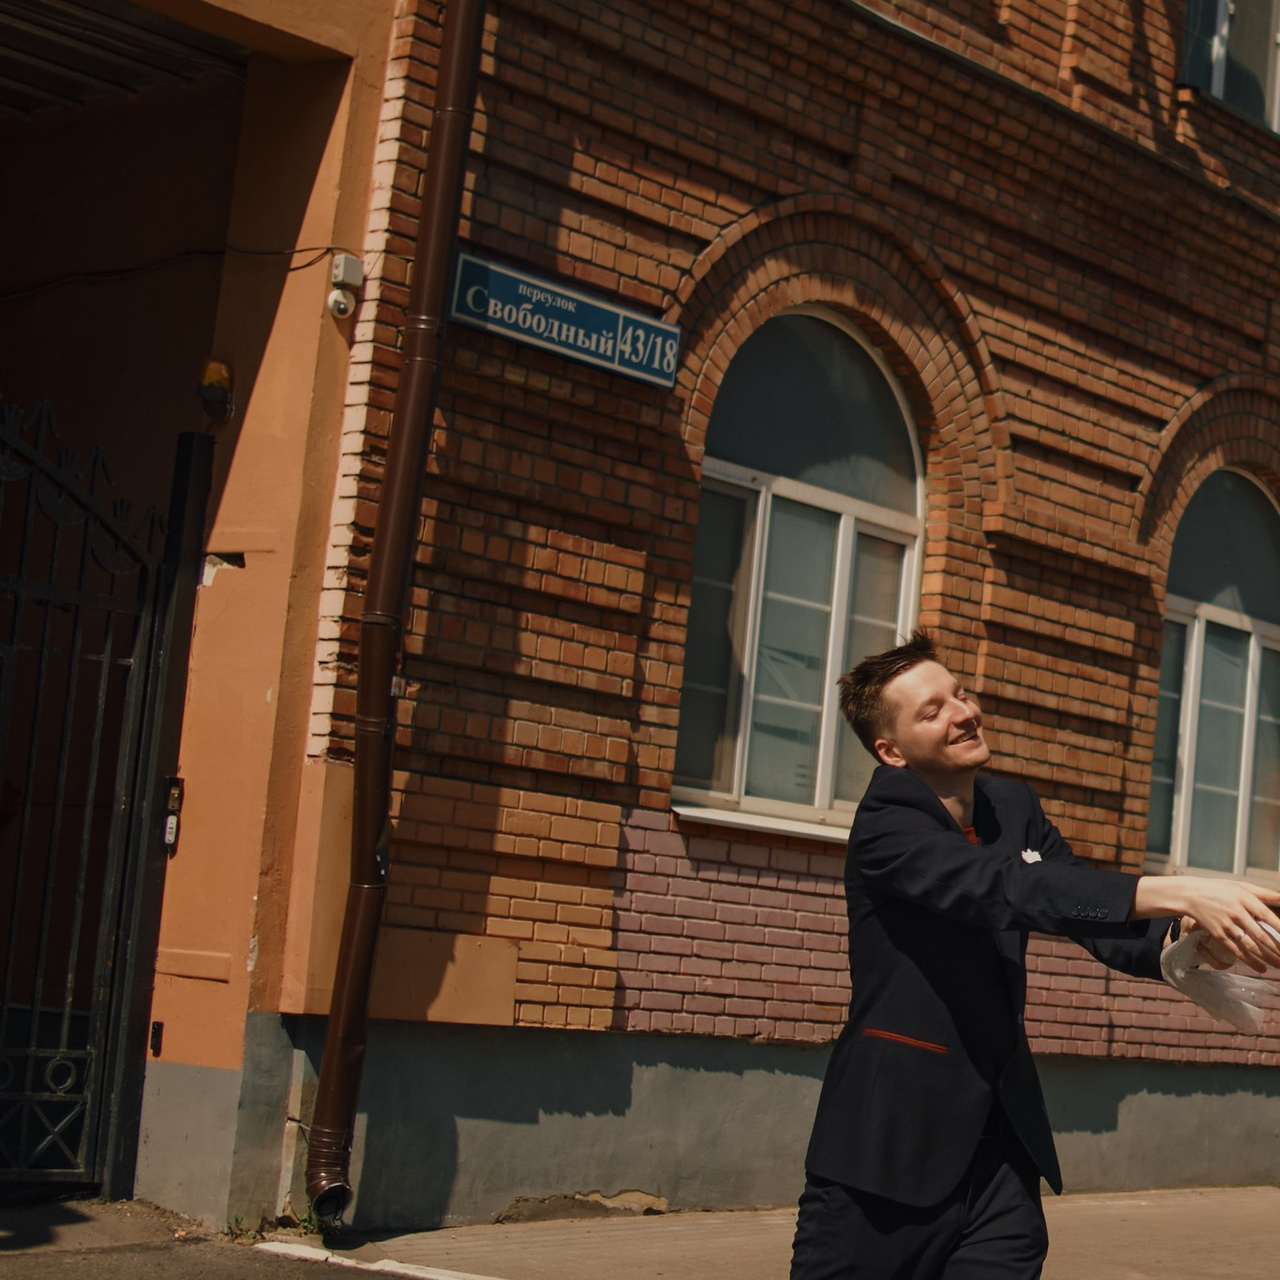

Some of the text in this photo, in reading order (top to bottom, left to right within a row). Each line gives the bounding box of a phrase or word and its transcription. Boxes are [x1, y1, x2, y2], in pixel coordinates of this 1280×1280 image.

[518, 282, 577, 314] переулок
[465, 285, 678, 374] Свободный 43/18
